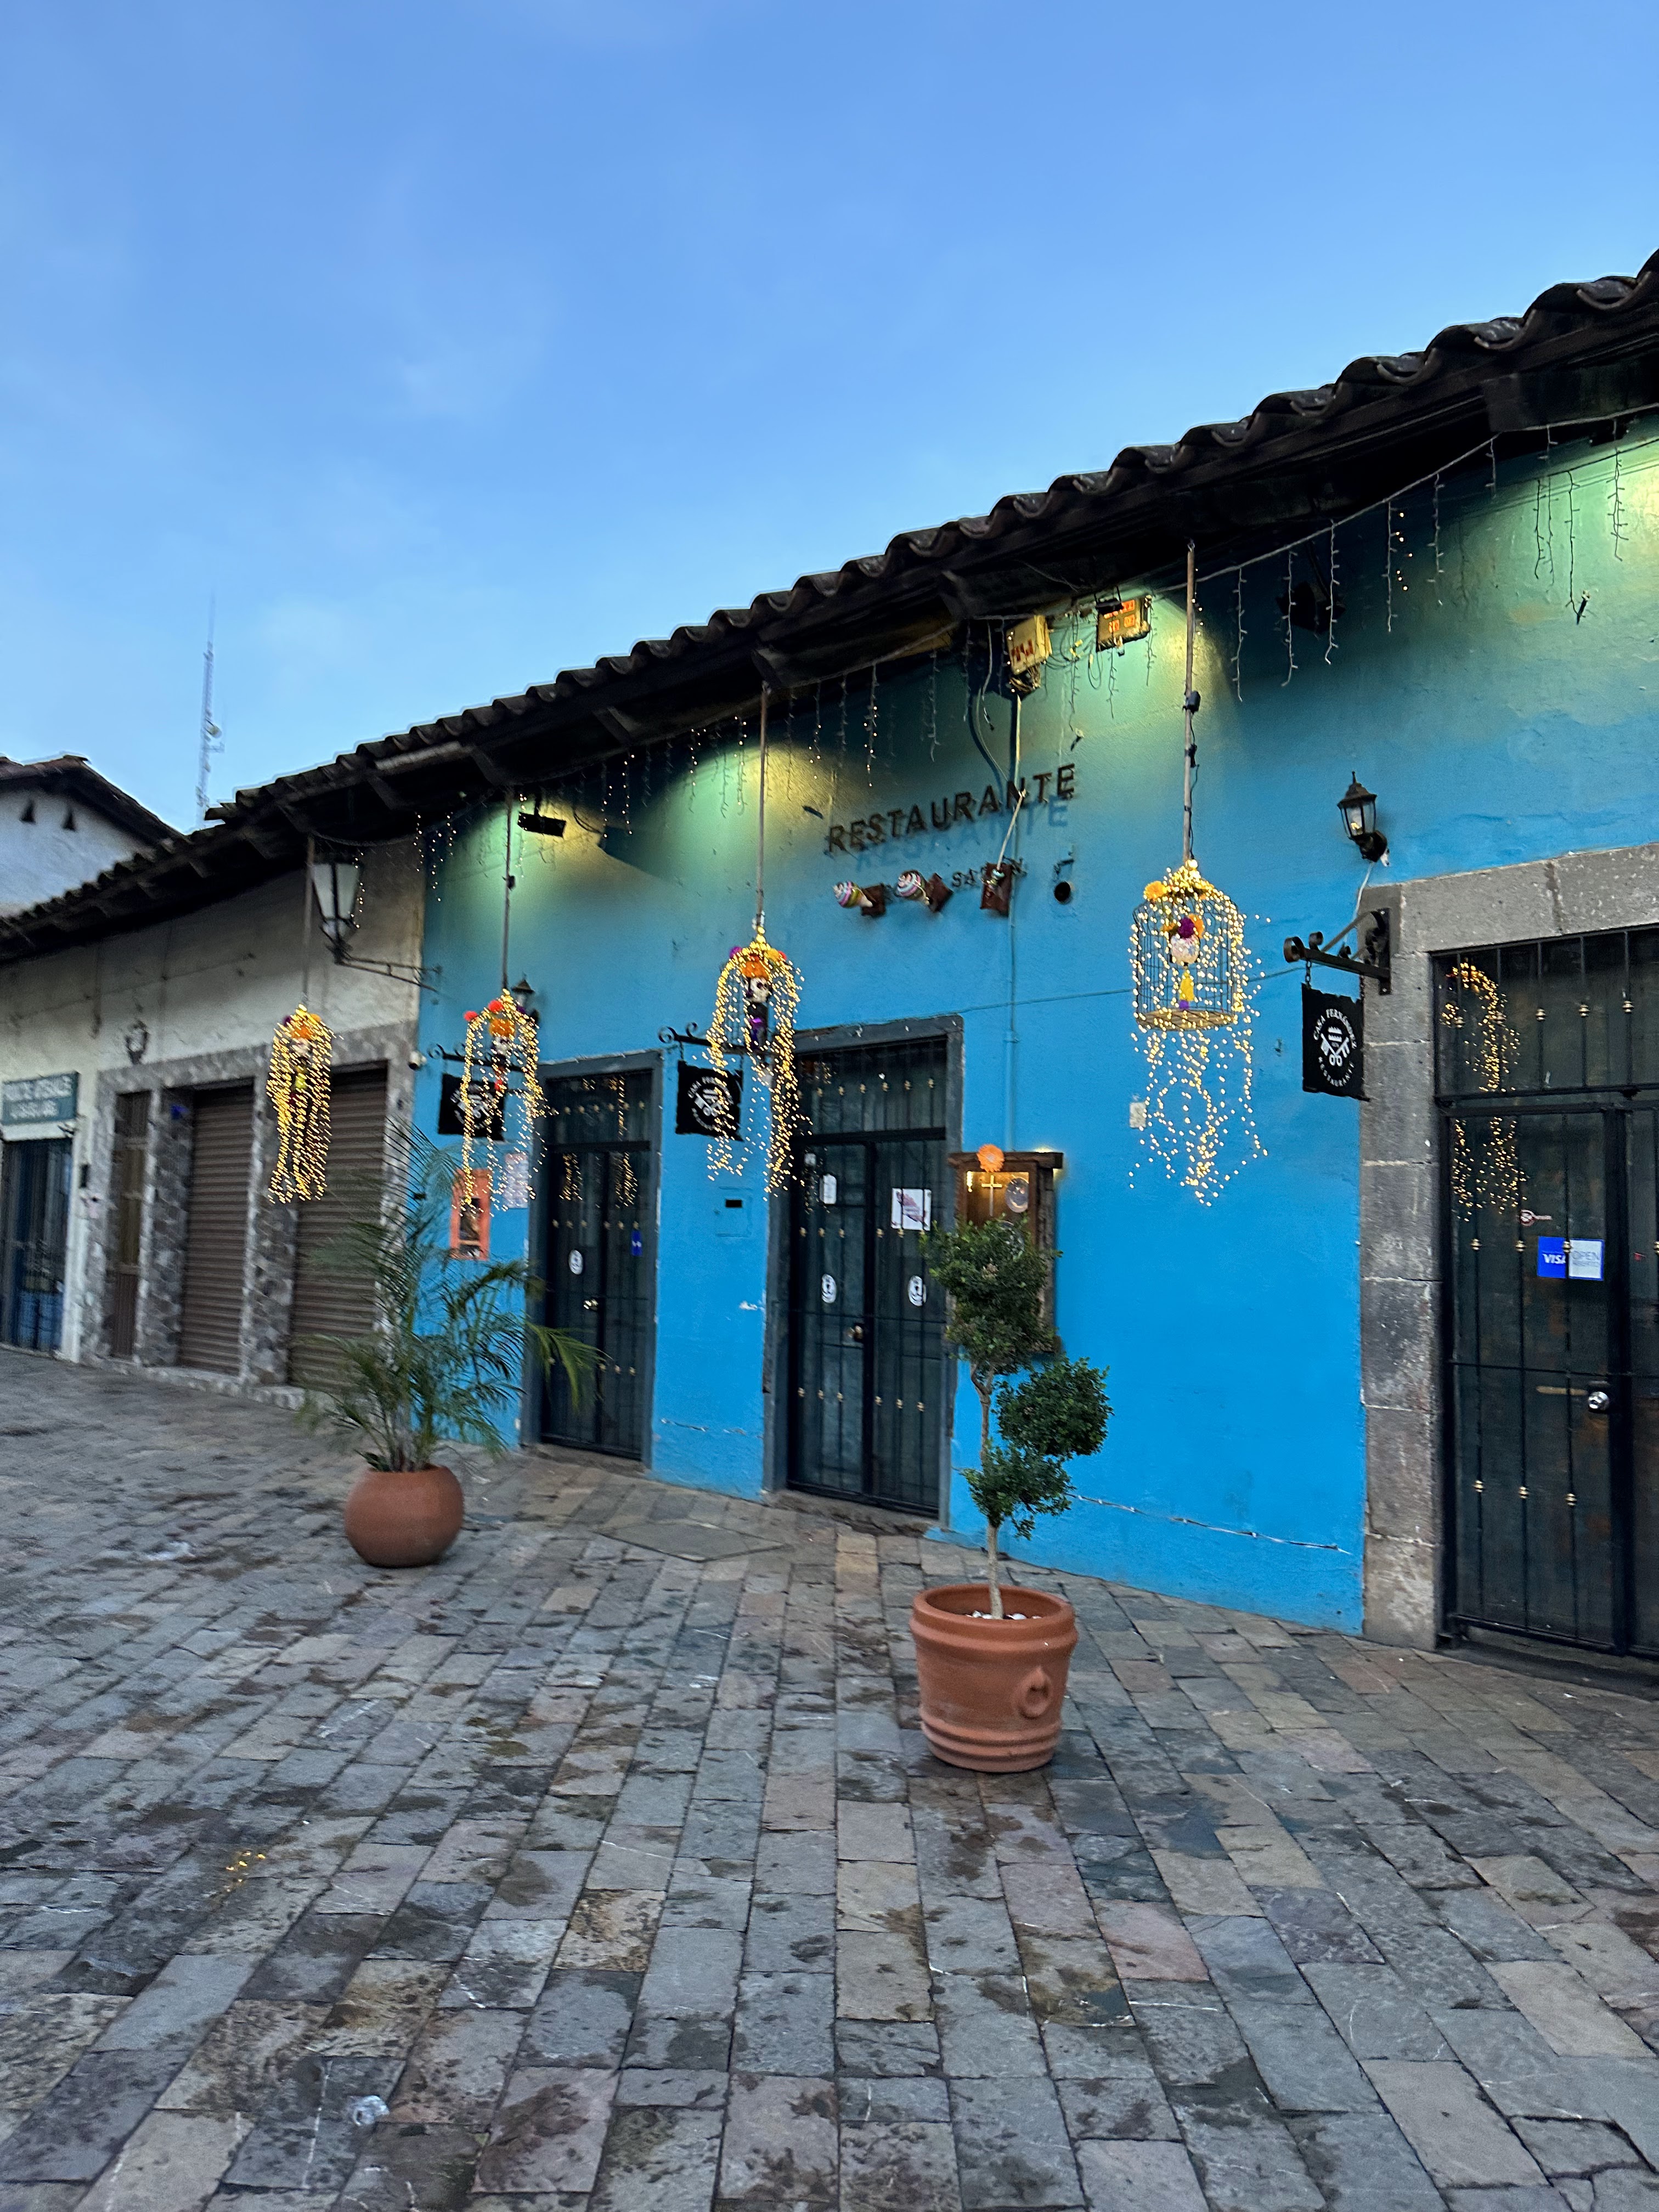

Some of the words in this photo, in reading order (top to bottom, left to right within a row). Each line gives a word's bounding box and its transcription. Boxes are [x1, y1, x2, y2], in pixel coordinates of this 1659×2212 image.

[827, 763, 1075, 854] RESTAURANTE
[1313, 1014, 1326, 1041] CASA
[1318, 1056, 1355, 1087] RESTAURANTE
